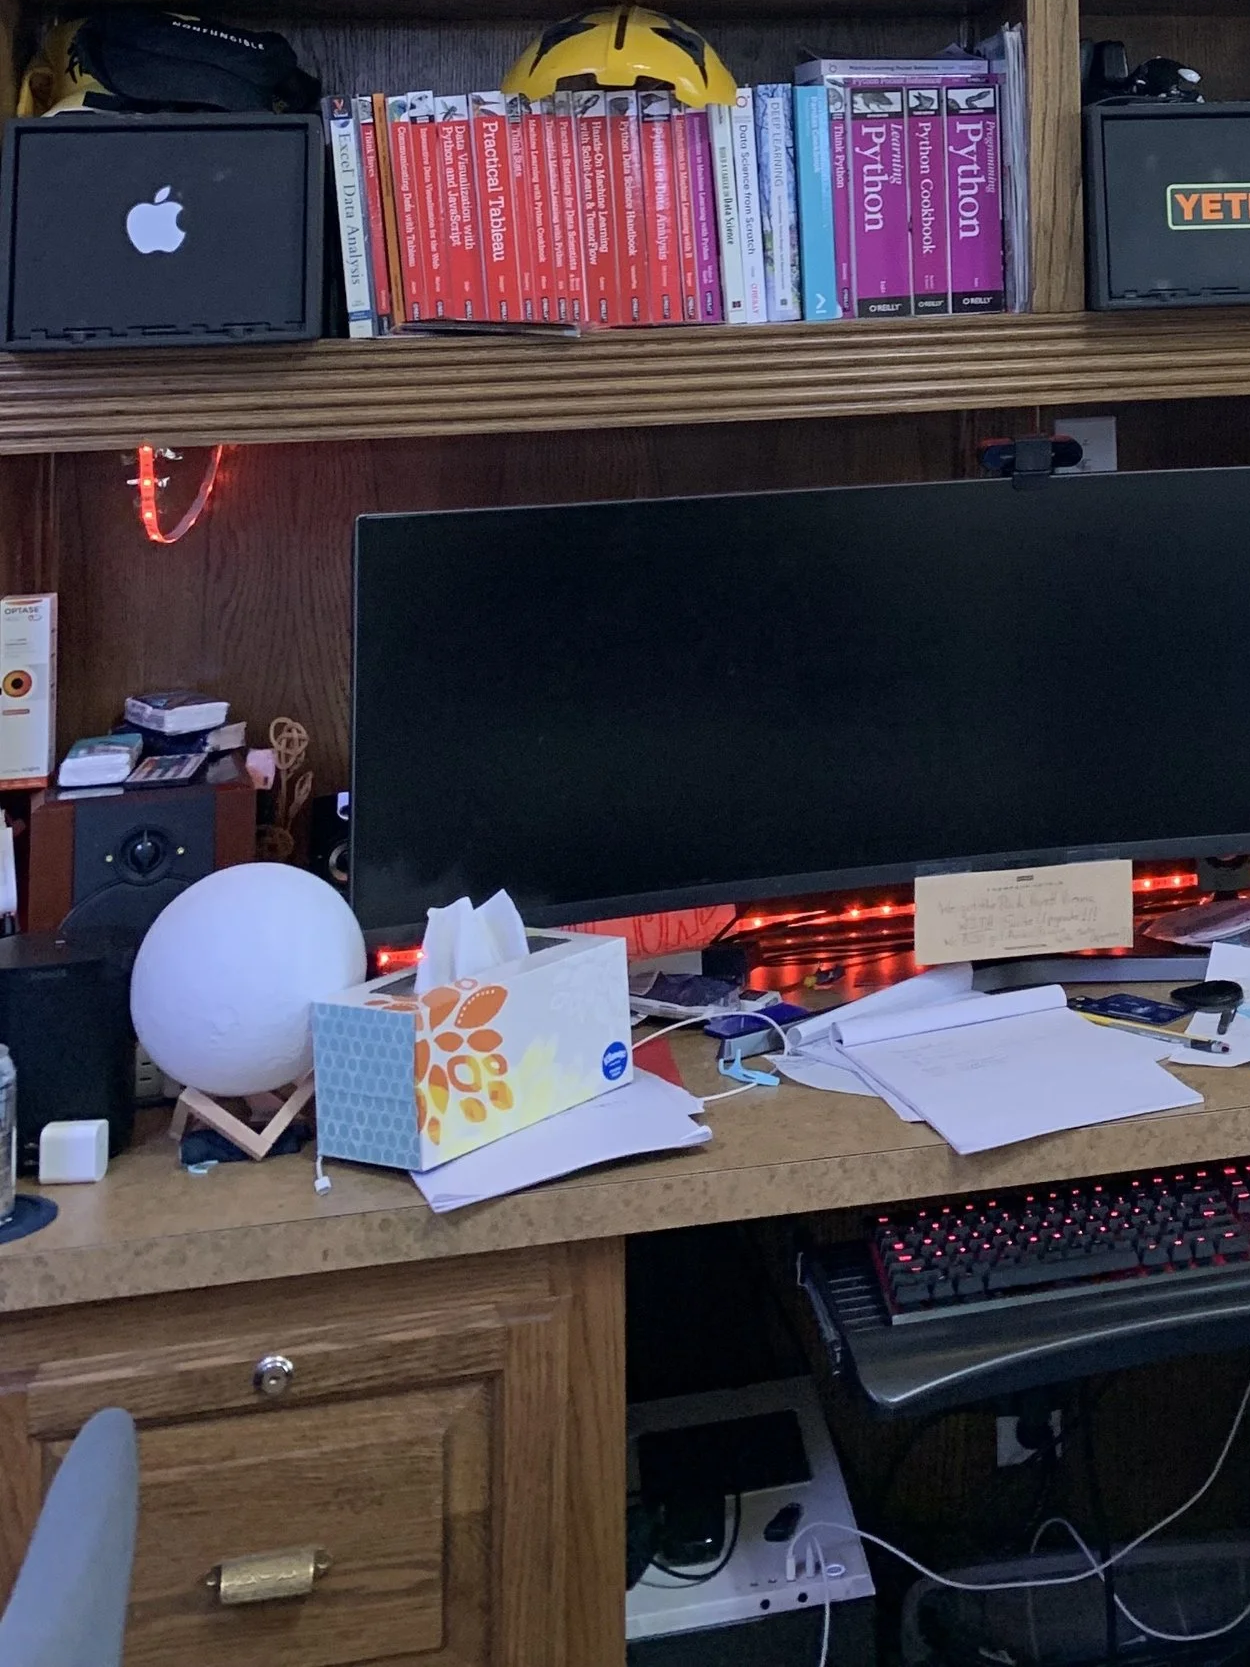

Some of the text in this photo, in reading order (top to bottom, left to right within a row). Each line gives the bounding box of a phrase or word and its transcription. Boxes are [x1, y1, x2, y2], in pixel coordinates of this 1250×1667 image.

[172, 21, 265, 50] NONFUNGIBLE
[441, 126, 461, 246] Python and JavaScript
[454, 125, 475, 250] Data Visualization with
[581, 122, 592, 144] with
[581, 145, 594, 199] Scikit-Learn
[592, 121, 610, 253] Hands-On Machine Learning
[620, 121, 637, 256] Python Data Science Handbook
[738, 124, 756, 255] Data Science from Scratch
[770, 102, 784, 188] DEEP LEARNING
[834, 124, 846, 188] Think Python
[854, 124, 887, 232] Python
[890, 123, 903, 185] Learning
[918, 122, 936, 254] Python Cookbook
[948, 121, 982, 239] Python
[985, 120, 997, 194] Programming
[337, 133, 364, 285] Excel Data Analysis
[397, 126, 416, 267] Communicating Data with Tableau
[482, 122, 506, 262] Practical Tableau
[586, 212, 598, 265] TensorFlow
[4, 606, 40, 615] OPTASE
